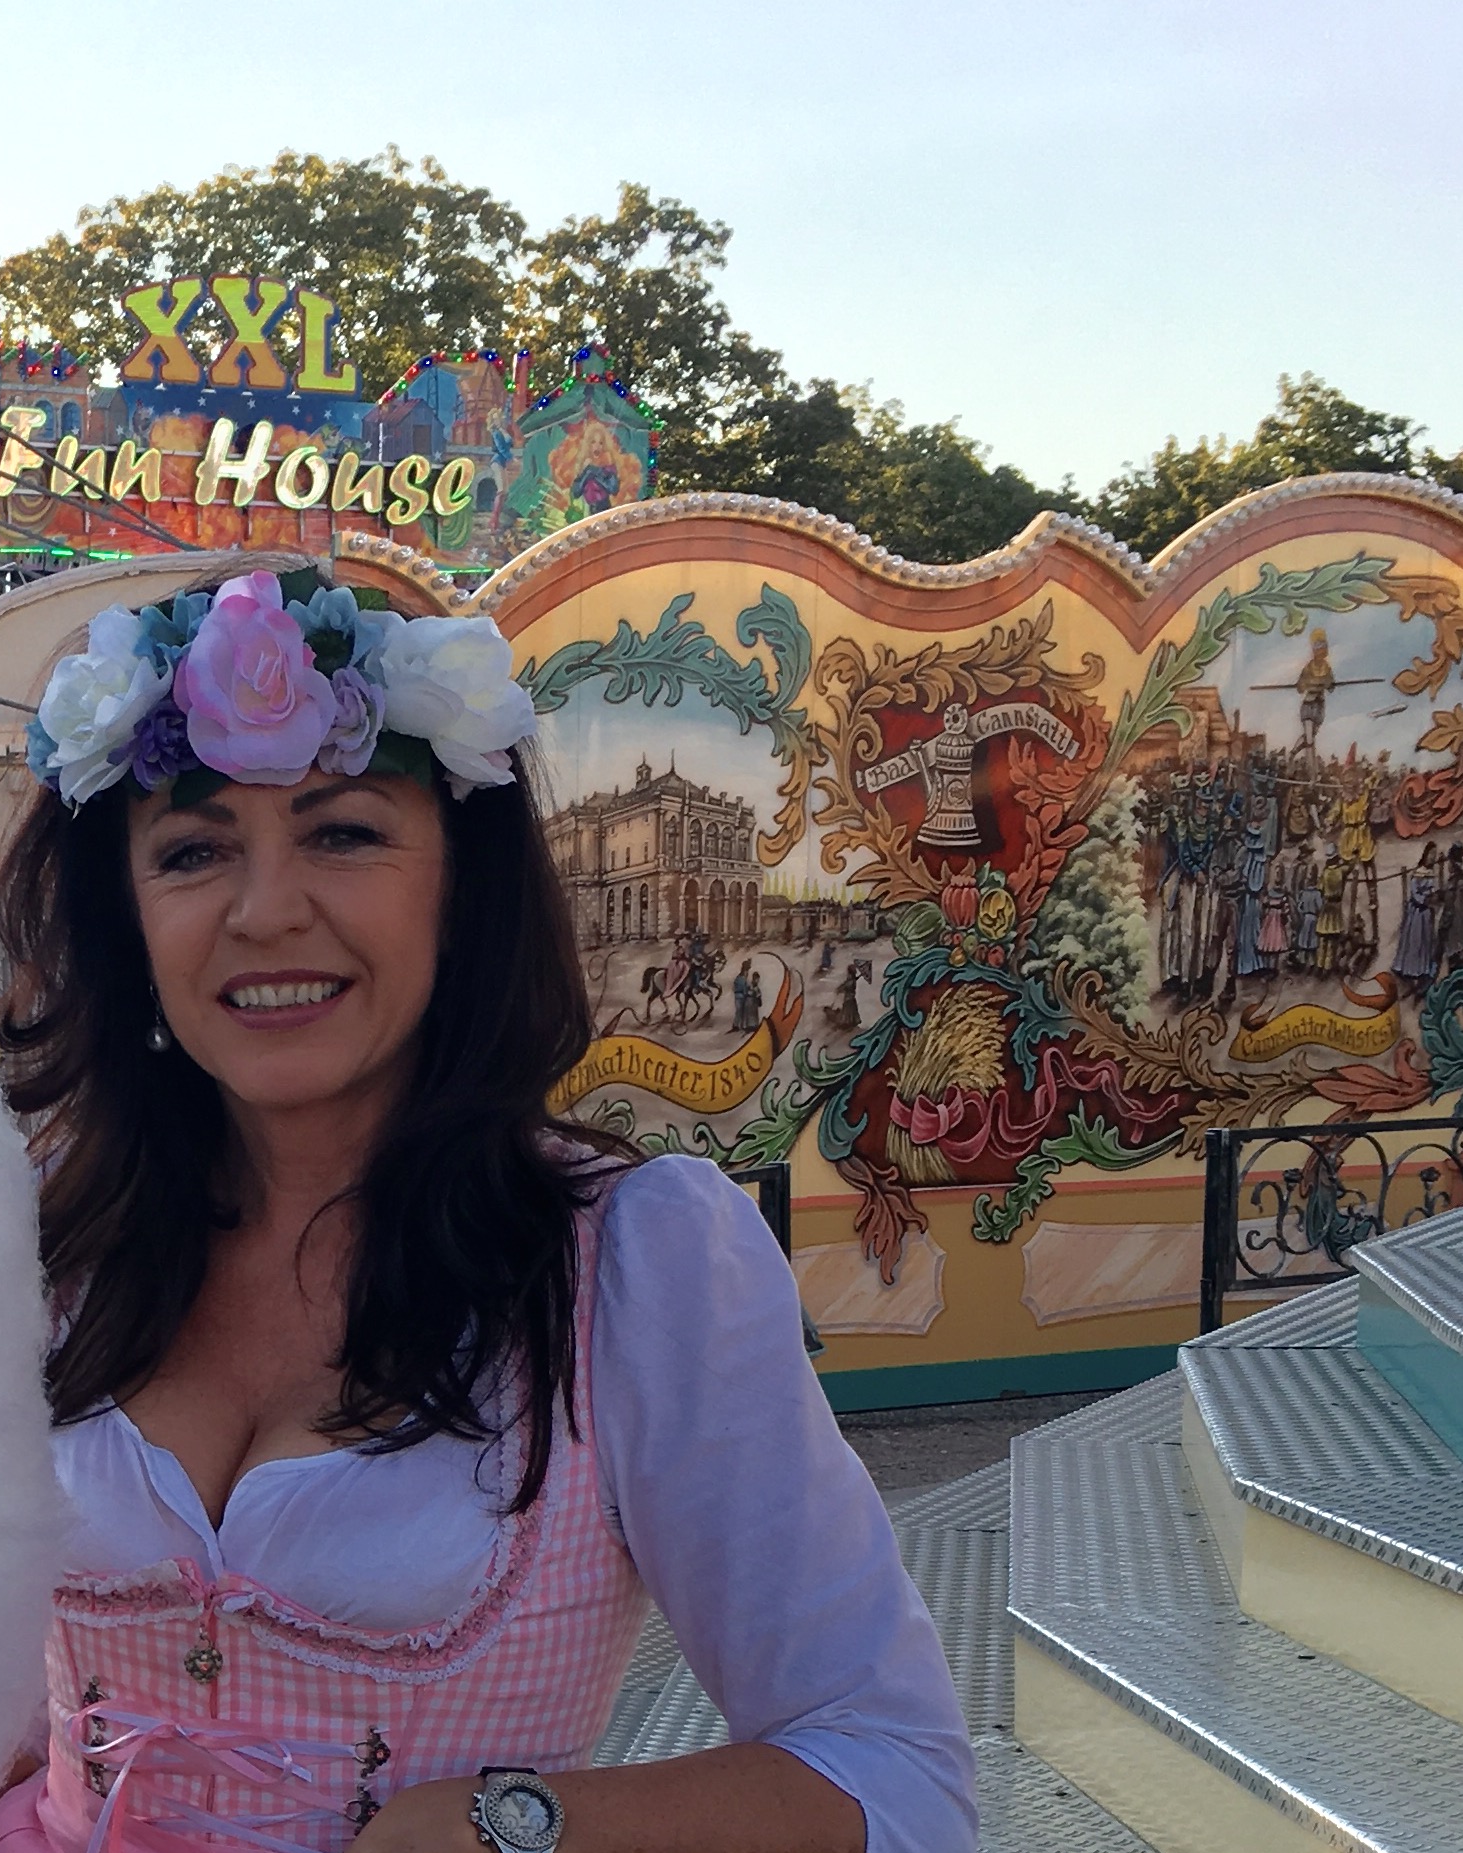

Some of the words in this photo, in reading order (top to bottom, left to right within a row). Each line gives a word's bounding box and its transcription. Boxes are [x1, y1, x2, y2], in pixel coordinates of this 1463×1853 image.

[122, 274, 359, 394] XXL
[195, 417, 476, 526] House
[869, 753, 916, 788] Bad
[709, 1052, 763, 1101] 1840
